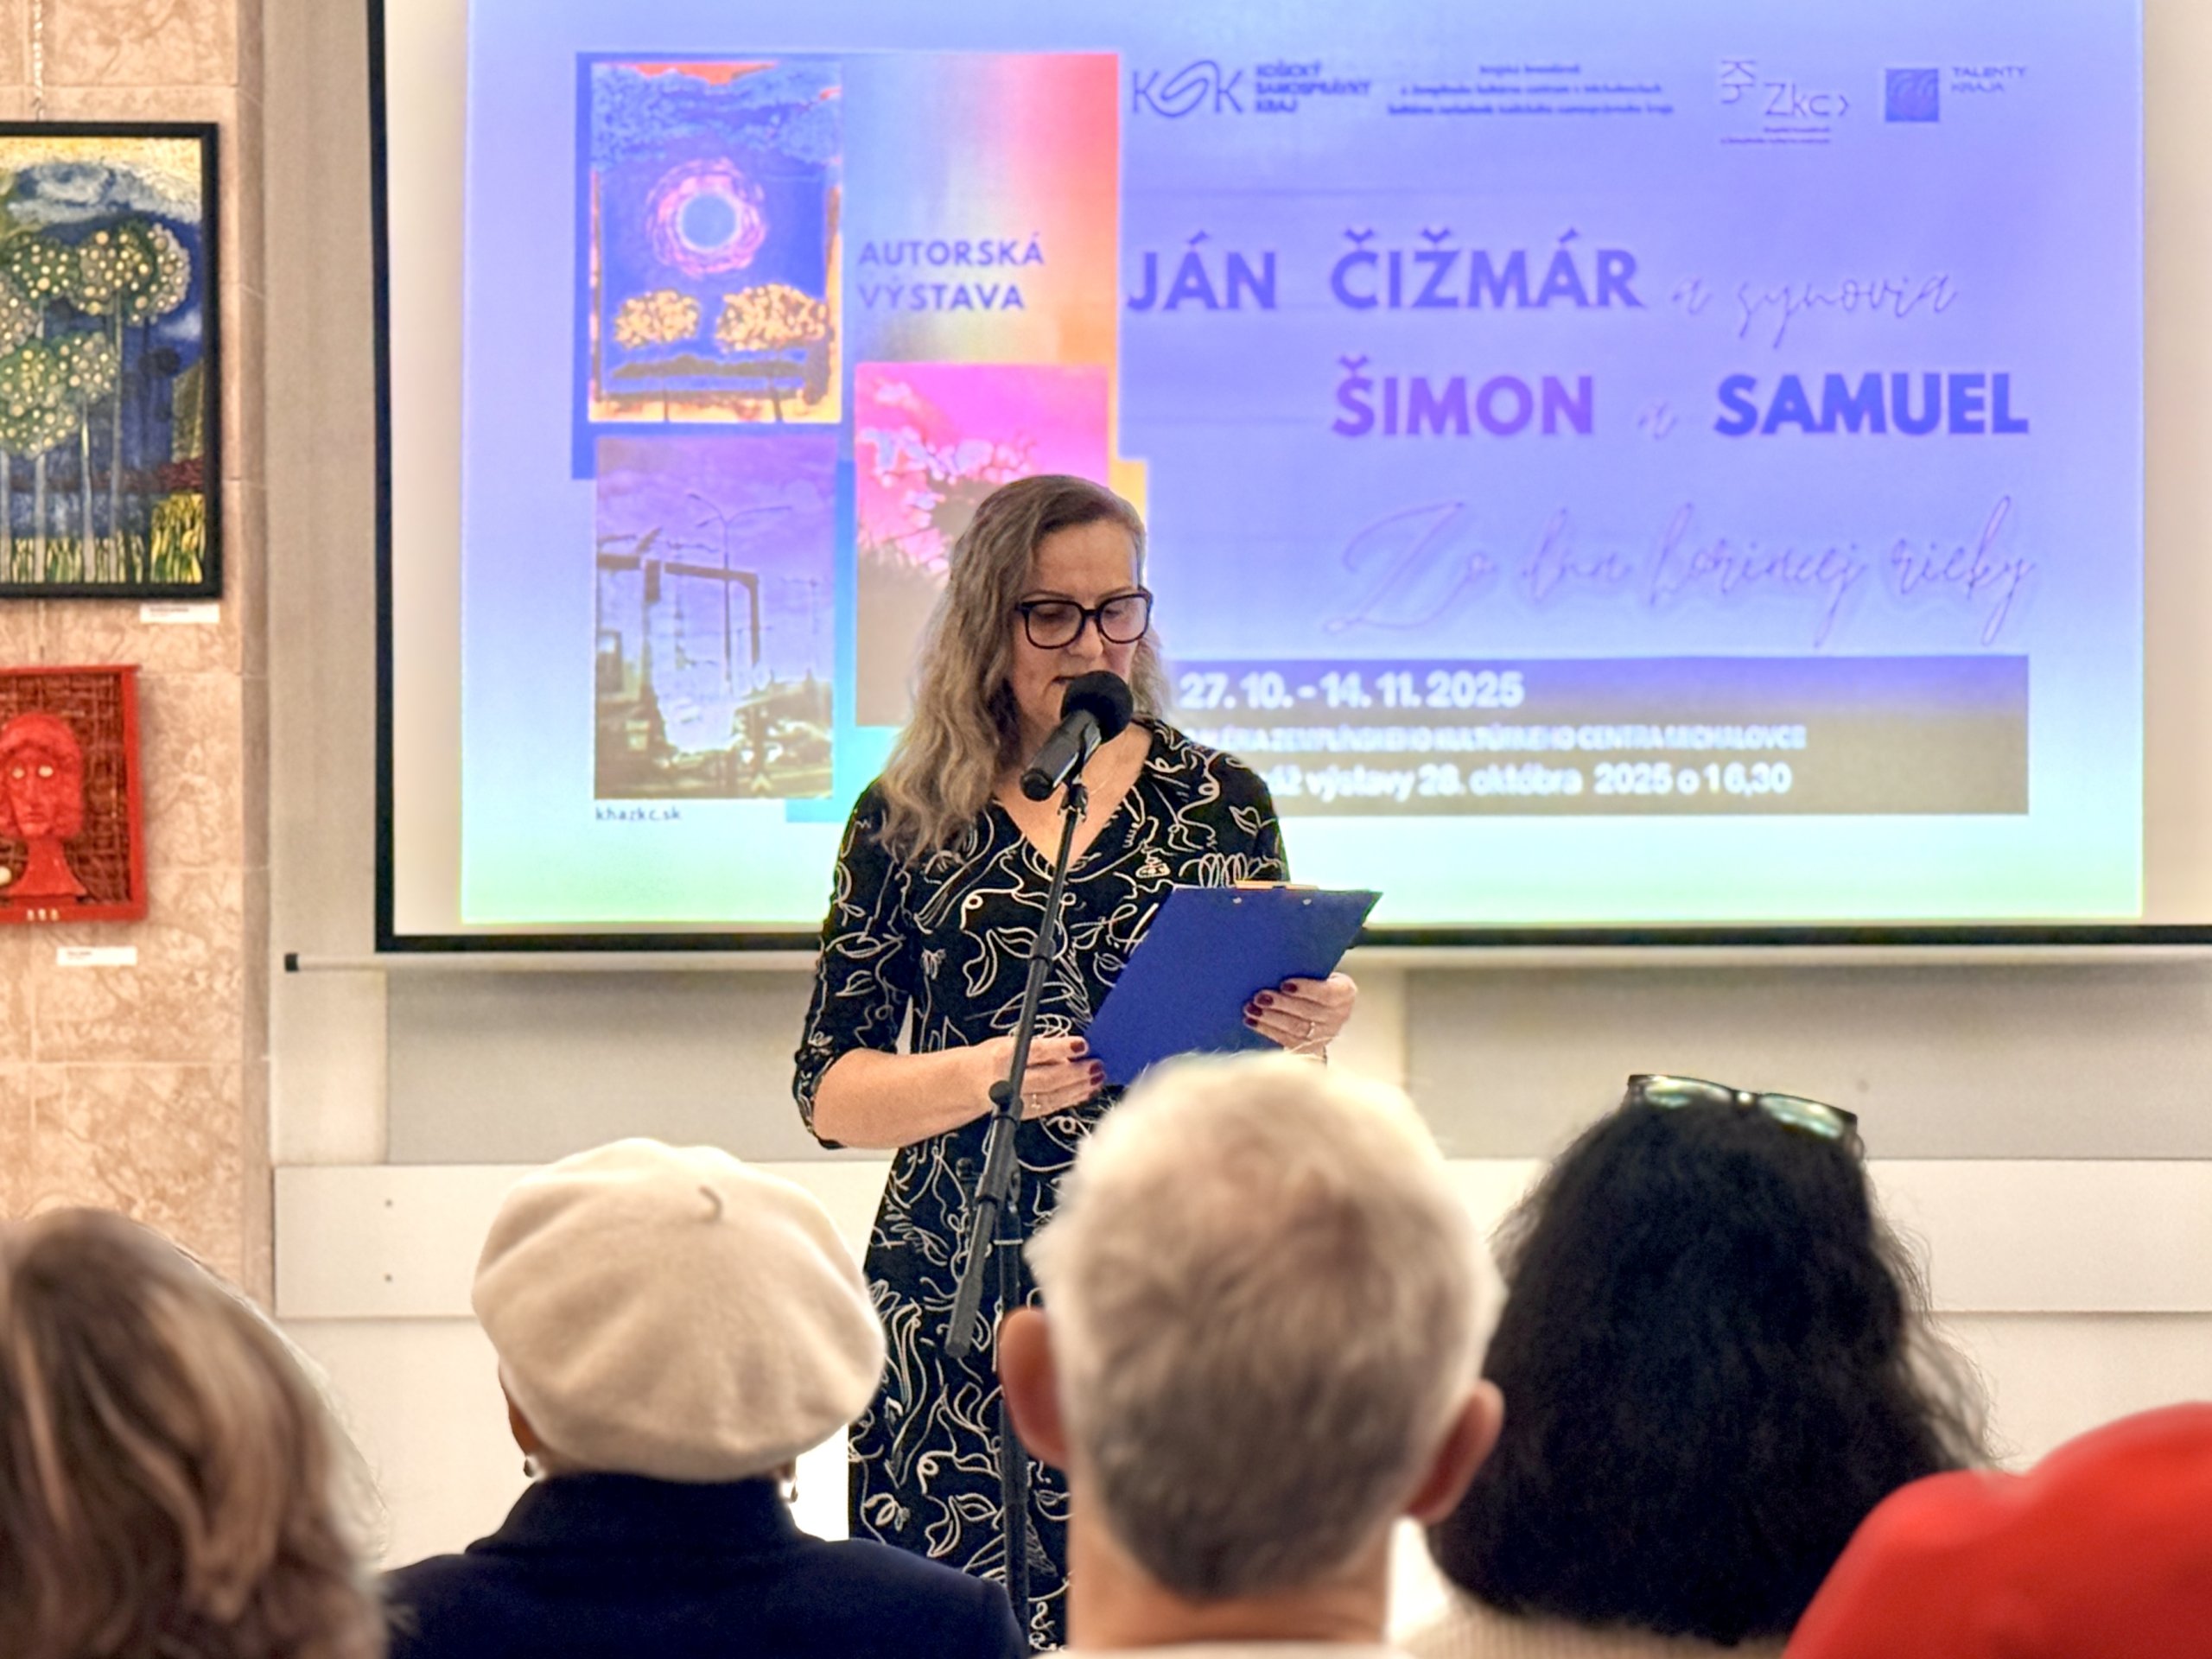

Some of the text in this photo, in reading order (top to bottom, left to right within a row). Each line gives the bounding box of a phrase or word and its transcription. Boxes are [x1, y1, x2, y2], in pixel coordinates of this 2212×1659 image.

[859, 231, 1044, 266] AUTORSKÁ
[1126, 229, 1277, 311] JÁN
[1330, 226, 1648, 310] ČIŽMÁR
[857, 274, 1025, 311] VÝSTAVA
[1332, 354, 1595, 438] ŠIMON
[1714, 372, 2031, 435] SAMUEL
[1178, 671, 1236, 710] 27.
[1239, 671, 1294, 709] 10.
[1319, 671, 1372, 709] 14.
[1376, 671, 1422, 709] 11.
[1425, 669, 1527, 709] 2025
[1593, 761, 1674, 795] 2025
